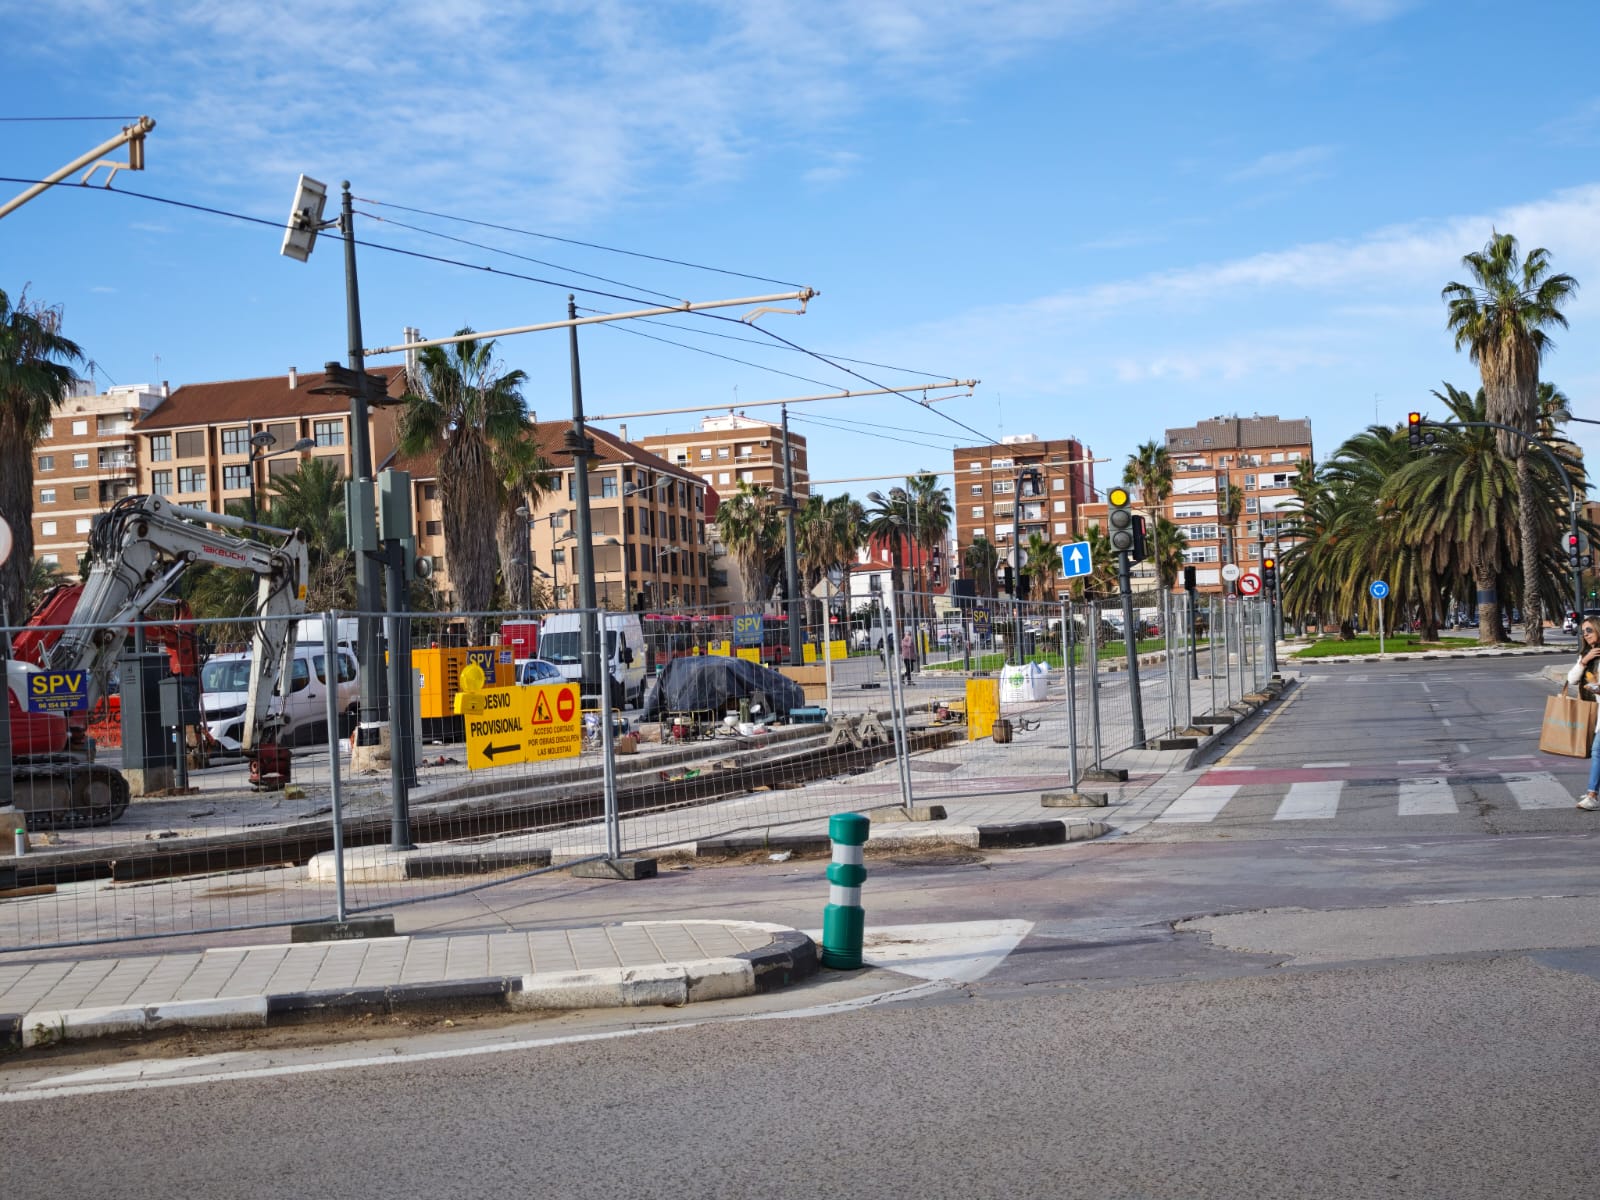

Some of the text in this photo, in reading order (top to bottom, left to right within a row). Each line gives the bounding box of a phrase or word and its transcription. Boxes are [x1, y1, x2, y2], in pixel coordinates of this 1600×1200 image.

[973, 610, 989, 623] SPV
[736, 617, 761, 632] SPV
[32, 673, 82, 694] SPV
[470, 716, 523, 737] PROVISIONAL
[533, 726, 553, 735] ACCESO
[528, 738, 539, 746] POR
[539, 736, 555, 745] OBRAS
[537, 748, 547, 756] LAS
